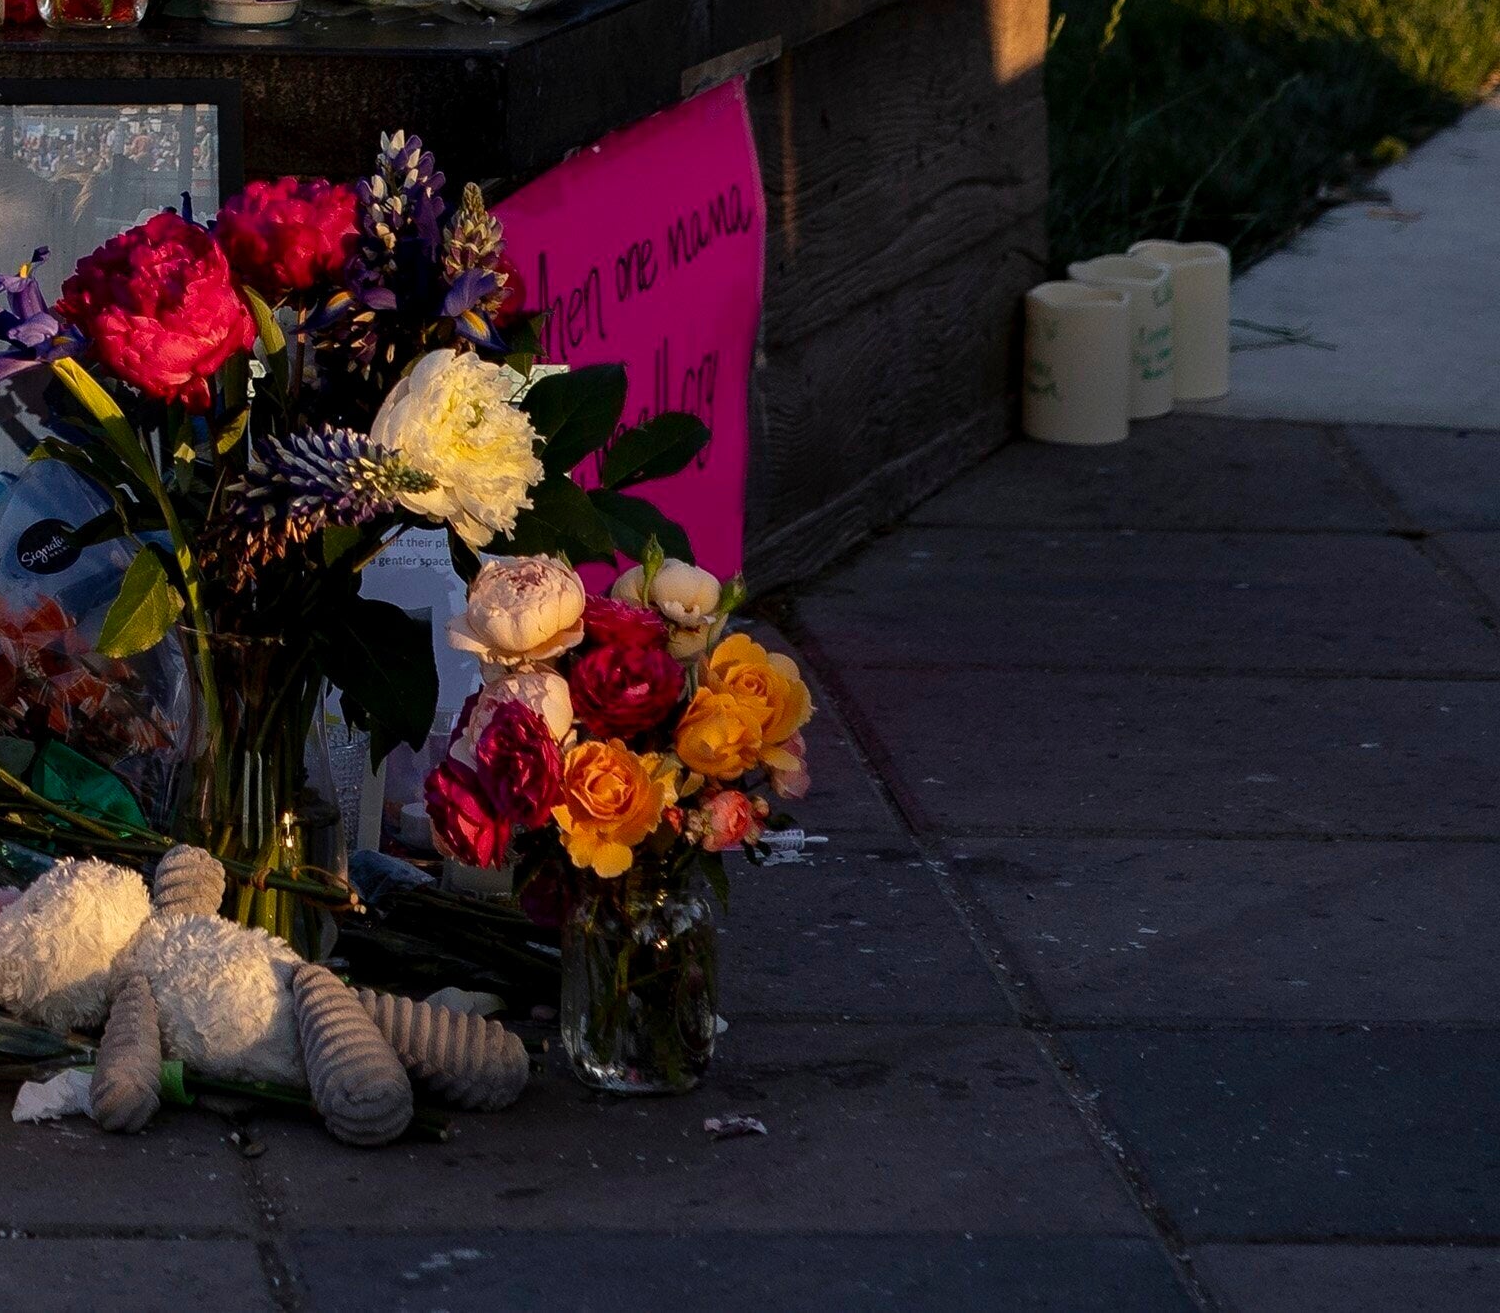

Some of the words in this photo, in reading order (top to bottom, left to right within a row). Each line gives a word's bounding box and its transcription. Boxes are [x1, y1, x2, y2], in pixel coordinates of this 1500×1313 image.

[537, 250, 606, 362] hen
[21, 535, 66, 567] Signatu
[406, 537, 431, 548] their
[378, 556, 417, 568] gentler
